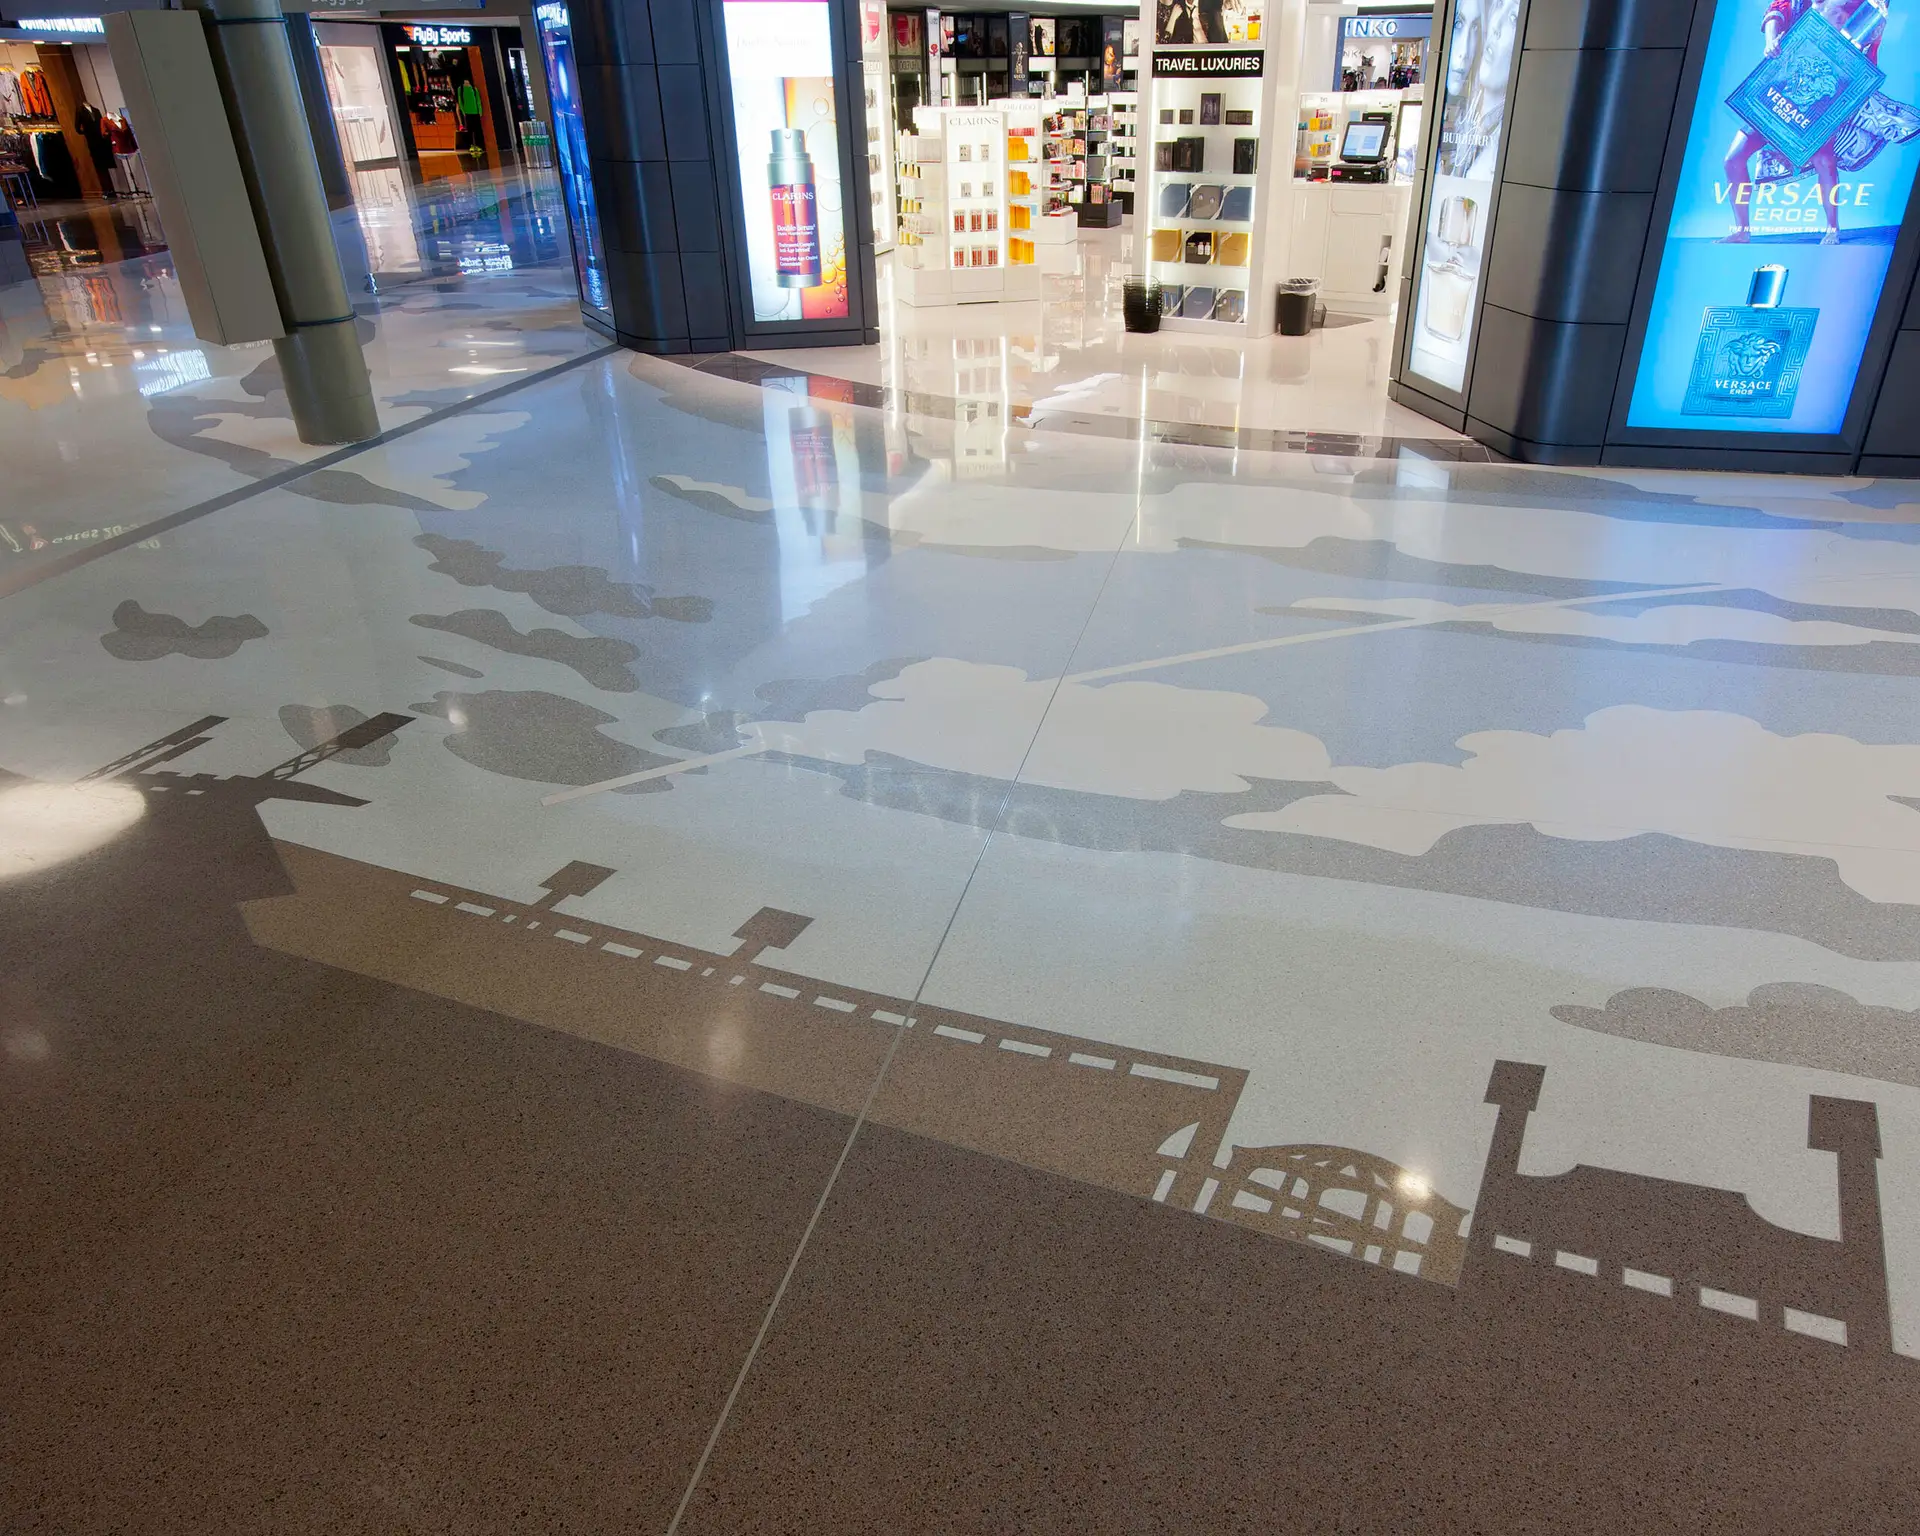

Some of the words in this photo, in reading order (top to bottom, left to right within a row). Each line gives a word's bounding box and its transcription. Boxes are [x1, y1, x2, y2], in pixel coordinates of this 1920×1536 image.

[413, 27, 438, 45] FlyBy
[440, 28, 471, 45] Sports
[1156, 58, 1199, 71] TRAVEL
[1201, 57, 1260, 71] LUXURIES
[1767, 87, 1810, 128] VERSACE
[950, 116, 999, 126] CLARINS
[1443, 131, 1494, 148] BURBERRY
[772, 192, 814, 200] CLARINS
[1714, 182, 1874, 206] VERSACE
[1754, 208, 1818, 222] EROS
[1715, 379, 1772, 390] VERSACE
